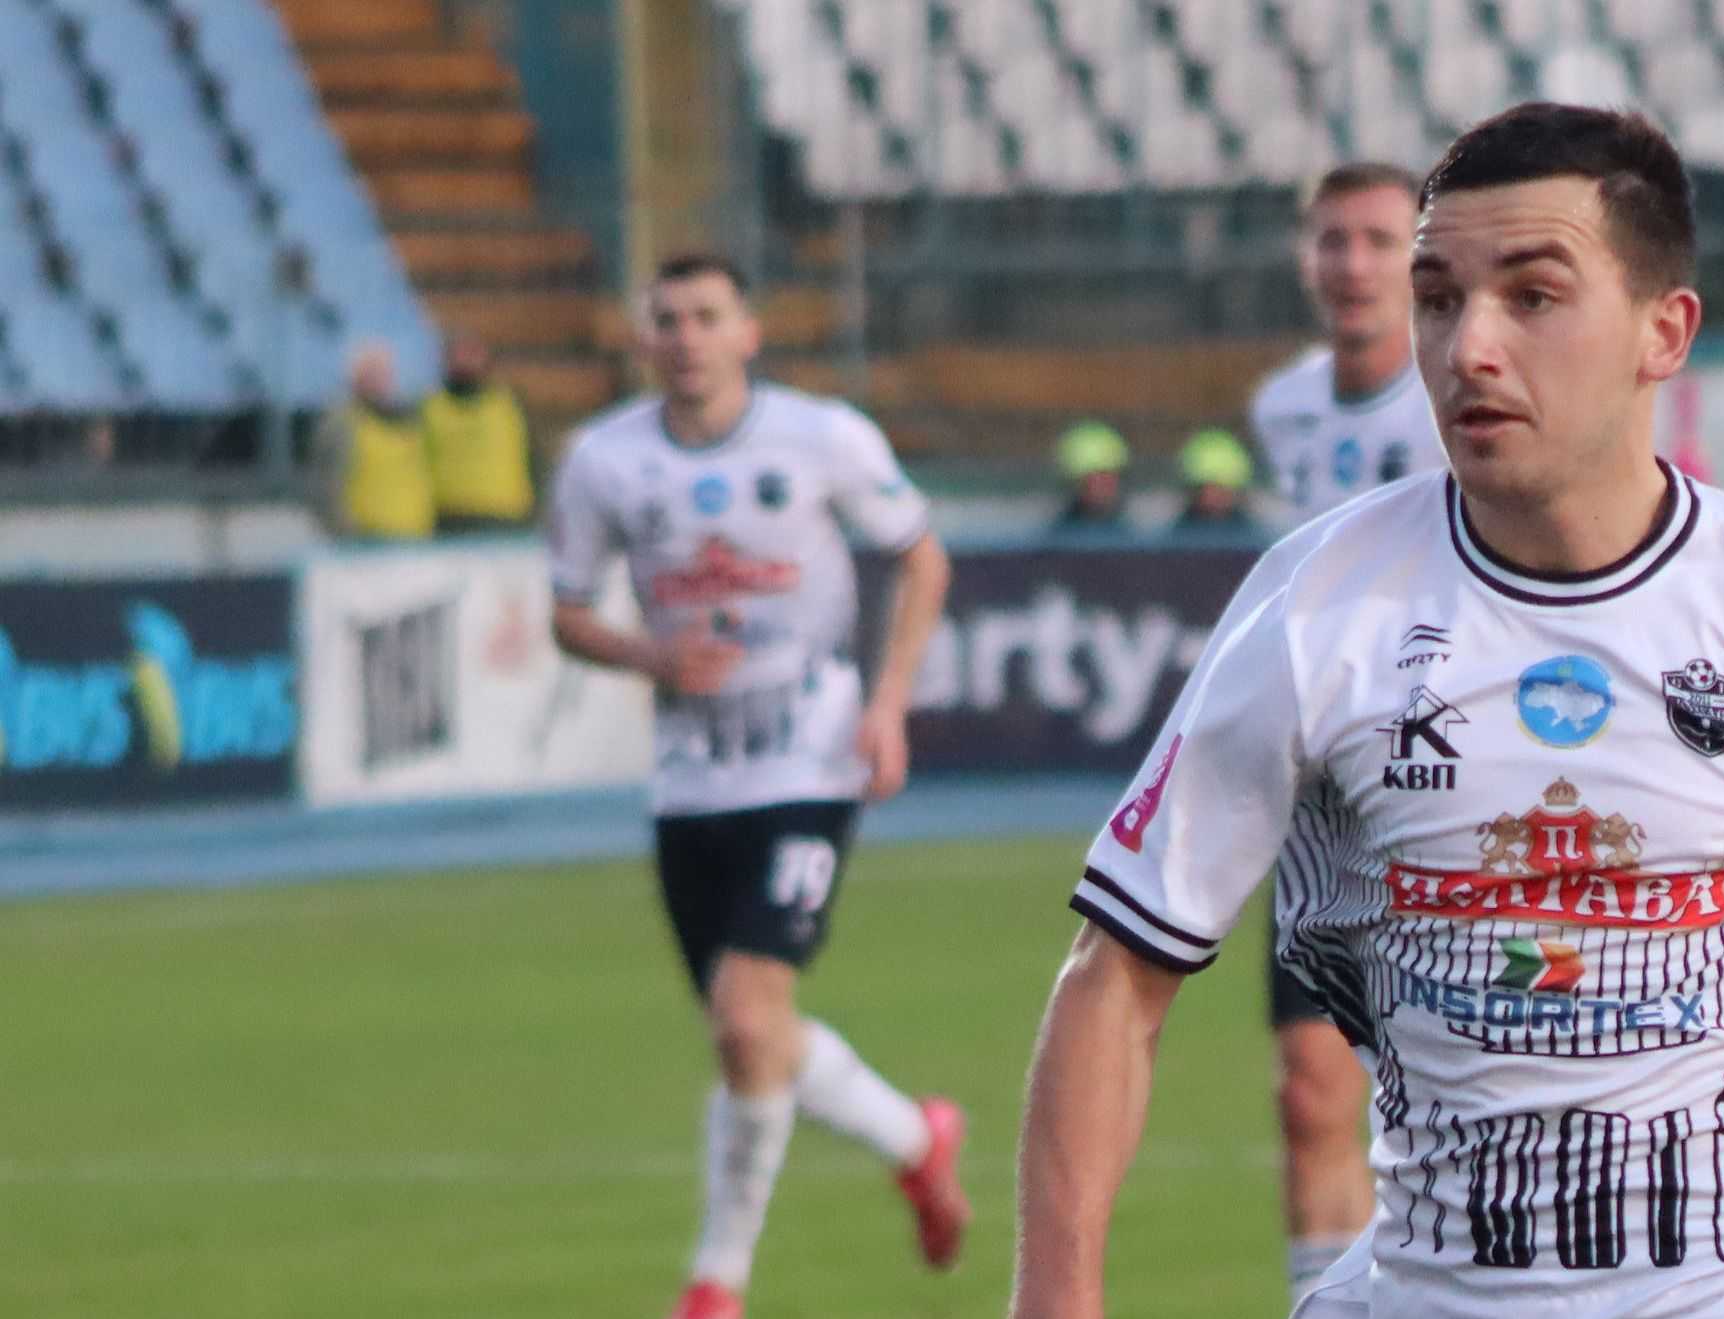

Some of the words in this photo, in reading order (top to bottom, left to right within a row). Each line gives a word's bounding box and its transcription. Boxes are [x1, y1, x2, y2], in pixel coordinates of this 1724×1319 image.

[1383, 764, 1456, 791] КВП
[1541, 825, 1583, 860] П
[1400, 969, 1706, 1036] INSORTEX
